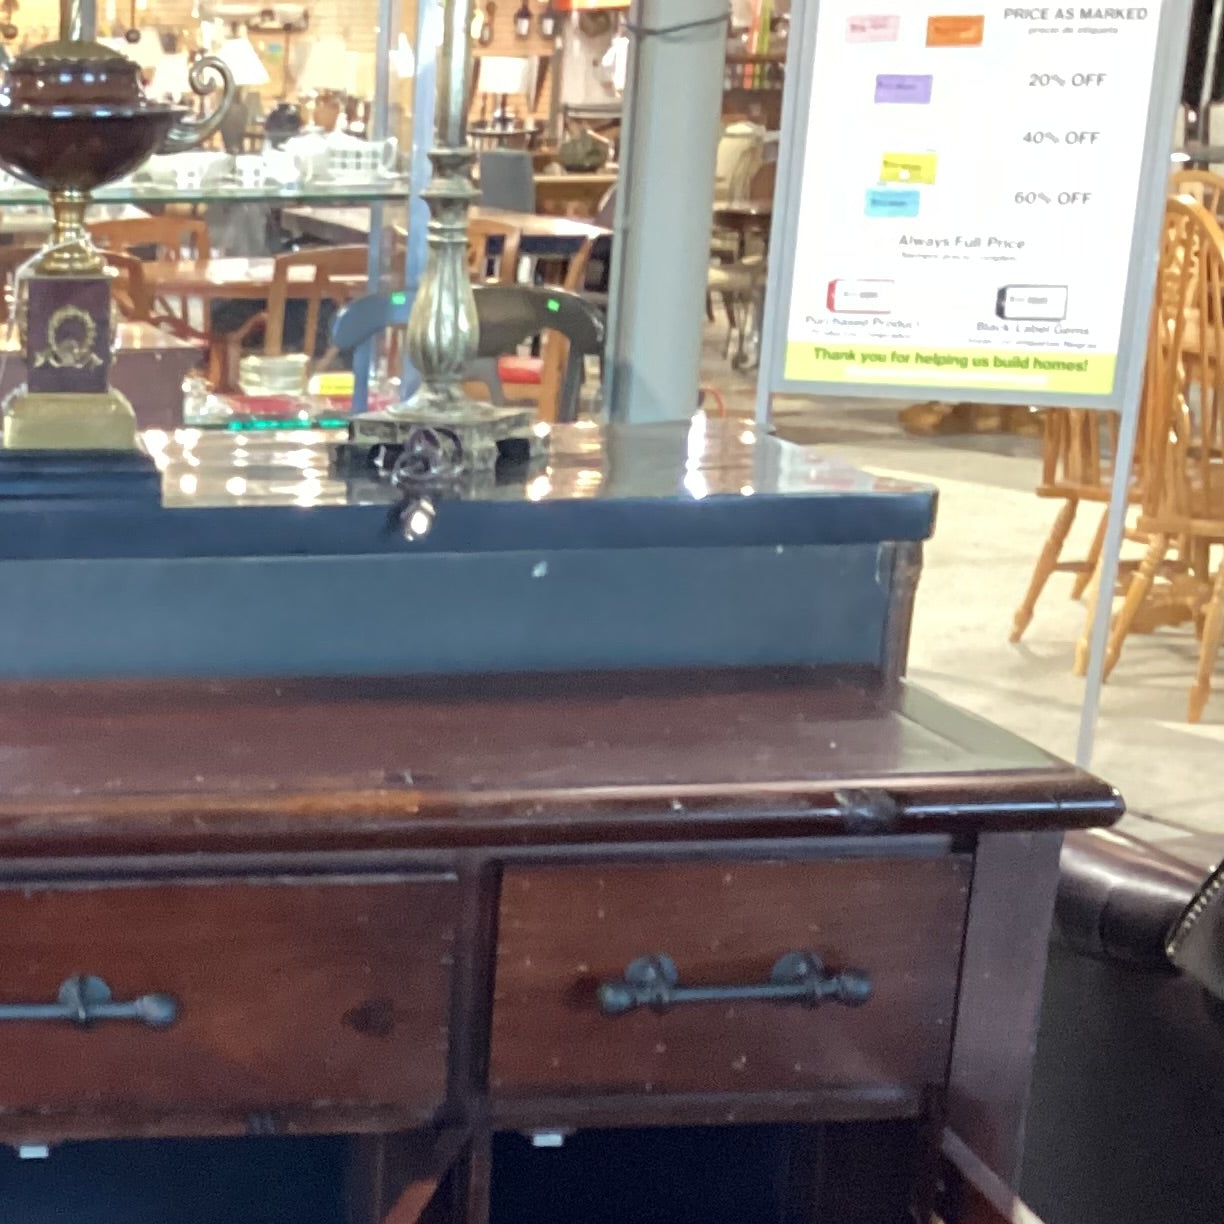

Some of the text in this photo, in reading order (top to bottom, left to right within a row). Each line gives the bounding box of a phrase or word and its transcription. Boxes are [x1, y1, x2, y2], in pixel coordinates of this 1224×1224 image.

[1003, 7, 1148, 20] PRICE AS MARKED
[1029, 73, 1107, 87] 20% OFF
[1023, 131, 1101, 144] 40% OFF
[1014, 191, 1093, 205] 60% OFF
[899, 234, 1025, 249] Always Full Price
[813, 346, 1089, 372] Thank you for helping us build homes!
